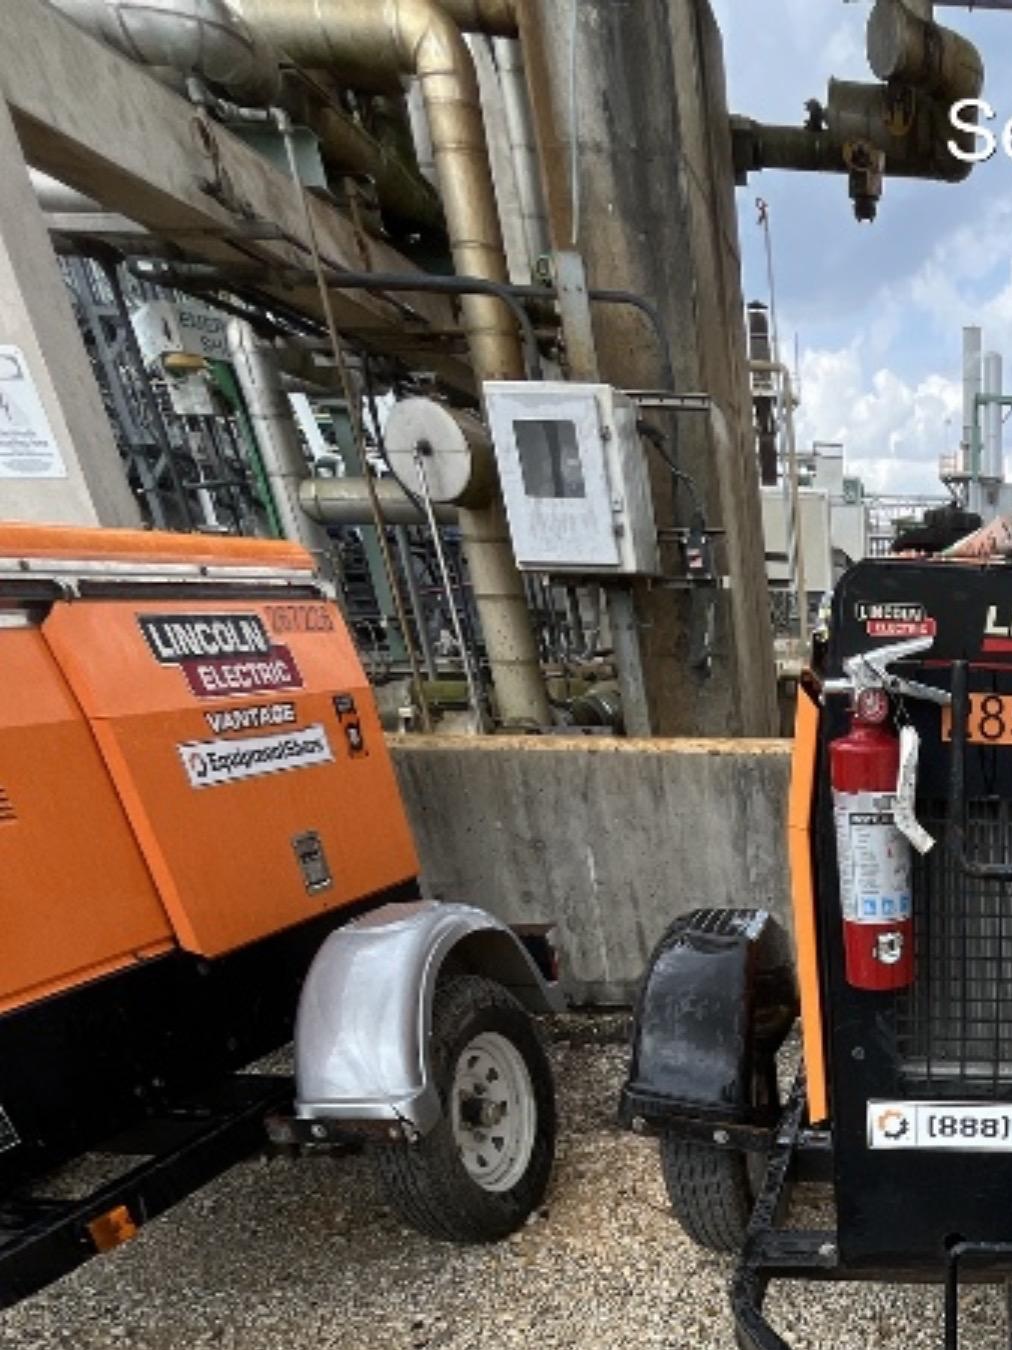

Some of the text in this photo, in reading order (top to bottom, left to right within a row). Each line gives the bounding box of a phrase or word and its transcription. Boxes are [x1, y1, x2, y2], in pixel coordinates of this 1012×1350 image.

[149, 619, 268, 658] LINCOLN
[197, 660, 293, 691] ELECTRIC
[205, 704, 295, 734] VANTAGE
